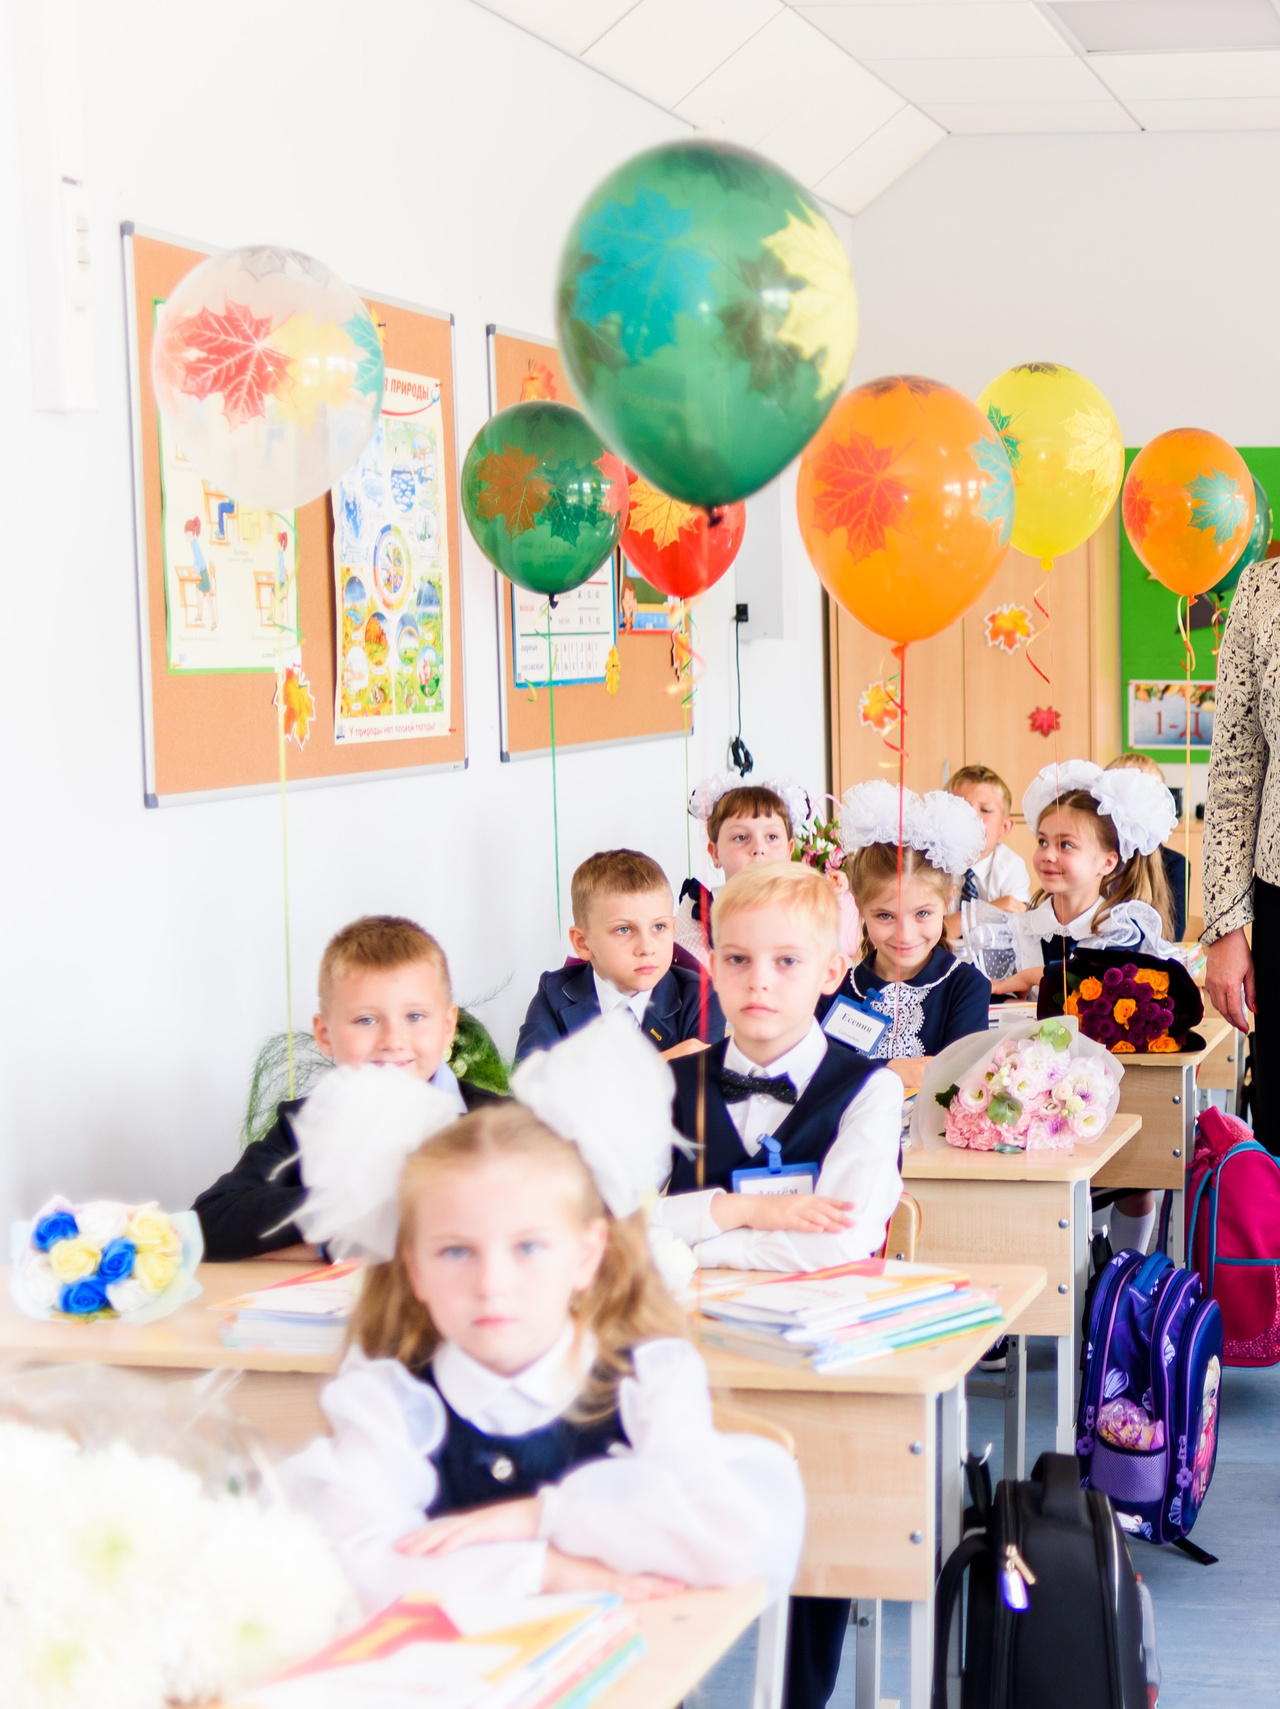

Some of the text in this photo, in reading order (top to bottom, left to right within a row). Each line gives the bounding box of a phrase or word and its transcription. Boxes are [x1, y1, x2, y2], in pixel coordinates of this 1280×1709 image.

[390, 379, 430, 402] ПРИРОДЫ
[355, 727, 382, 738] природы
[841, 1012, 872, 1033] Есения
